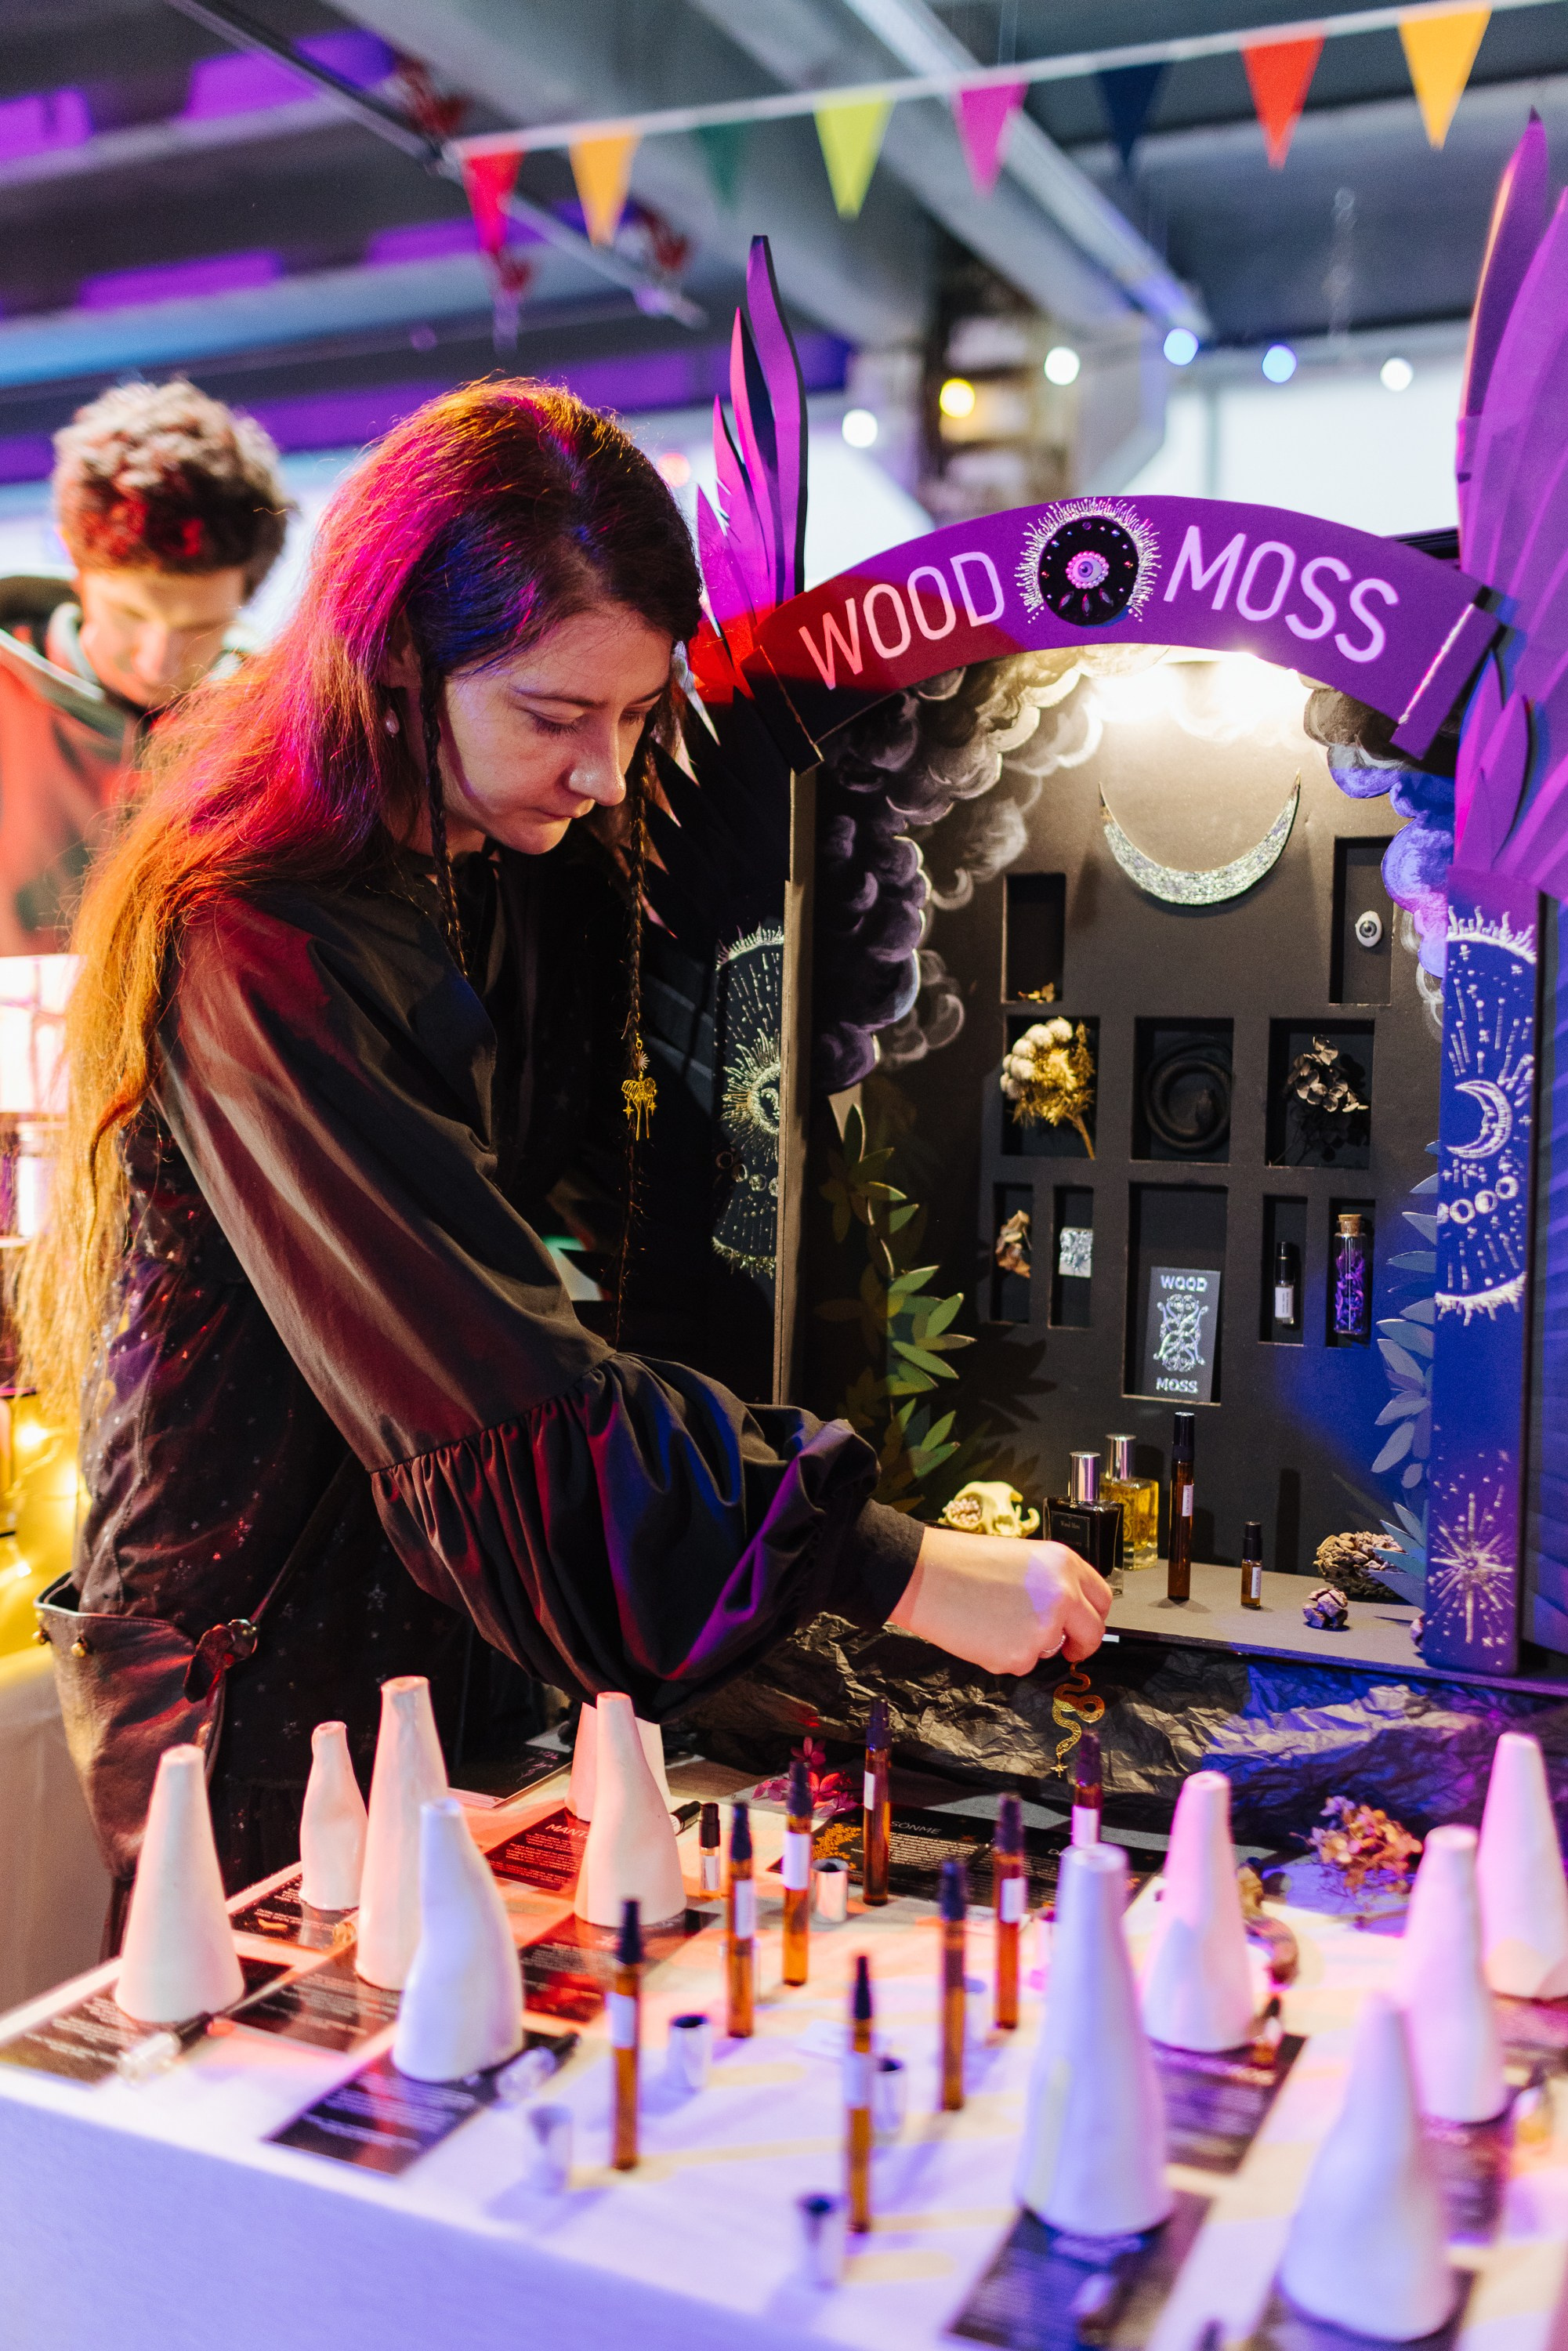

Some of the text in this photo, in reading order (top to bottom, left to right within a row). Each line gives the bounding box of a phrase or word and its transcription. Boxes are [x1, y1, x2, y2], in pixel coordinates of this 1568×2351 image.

[798, 525, 1400, 690] WOOD MOSS
[1160, 1274, 1208, 1292] WOOD
[1155, 1376, 1198, 1393] MOSS
[545, 1824, 589, 1838] MANT
